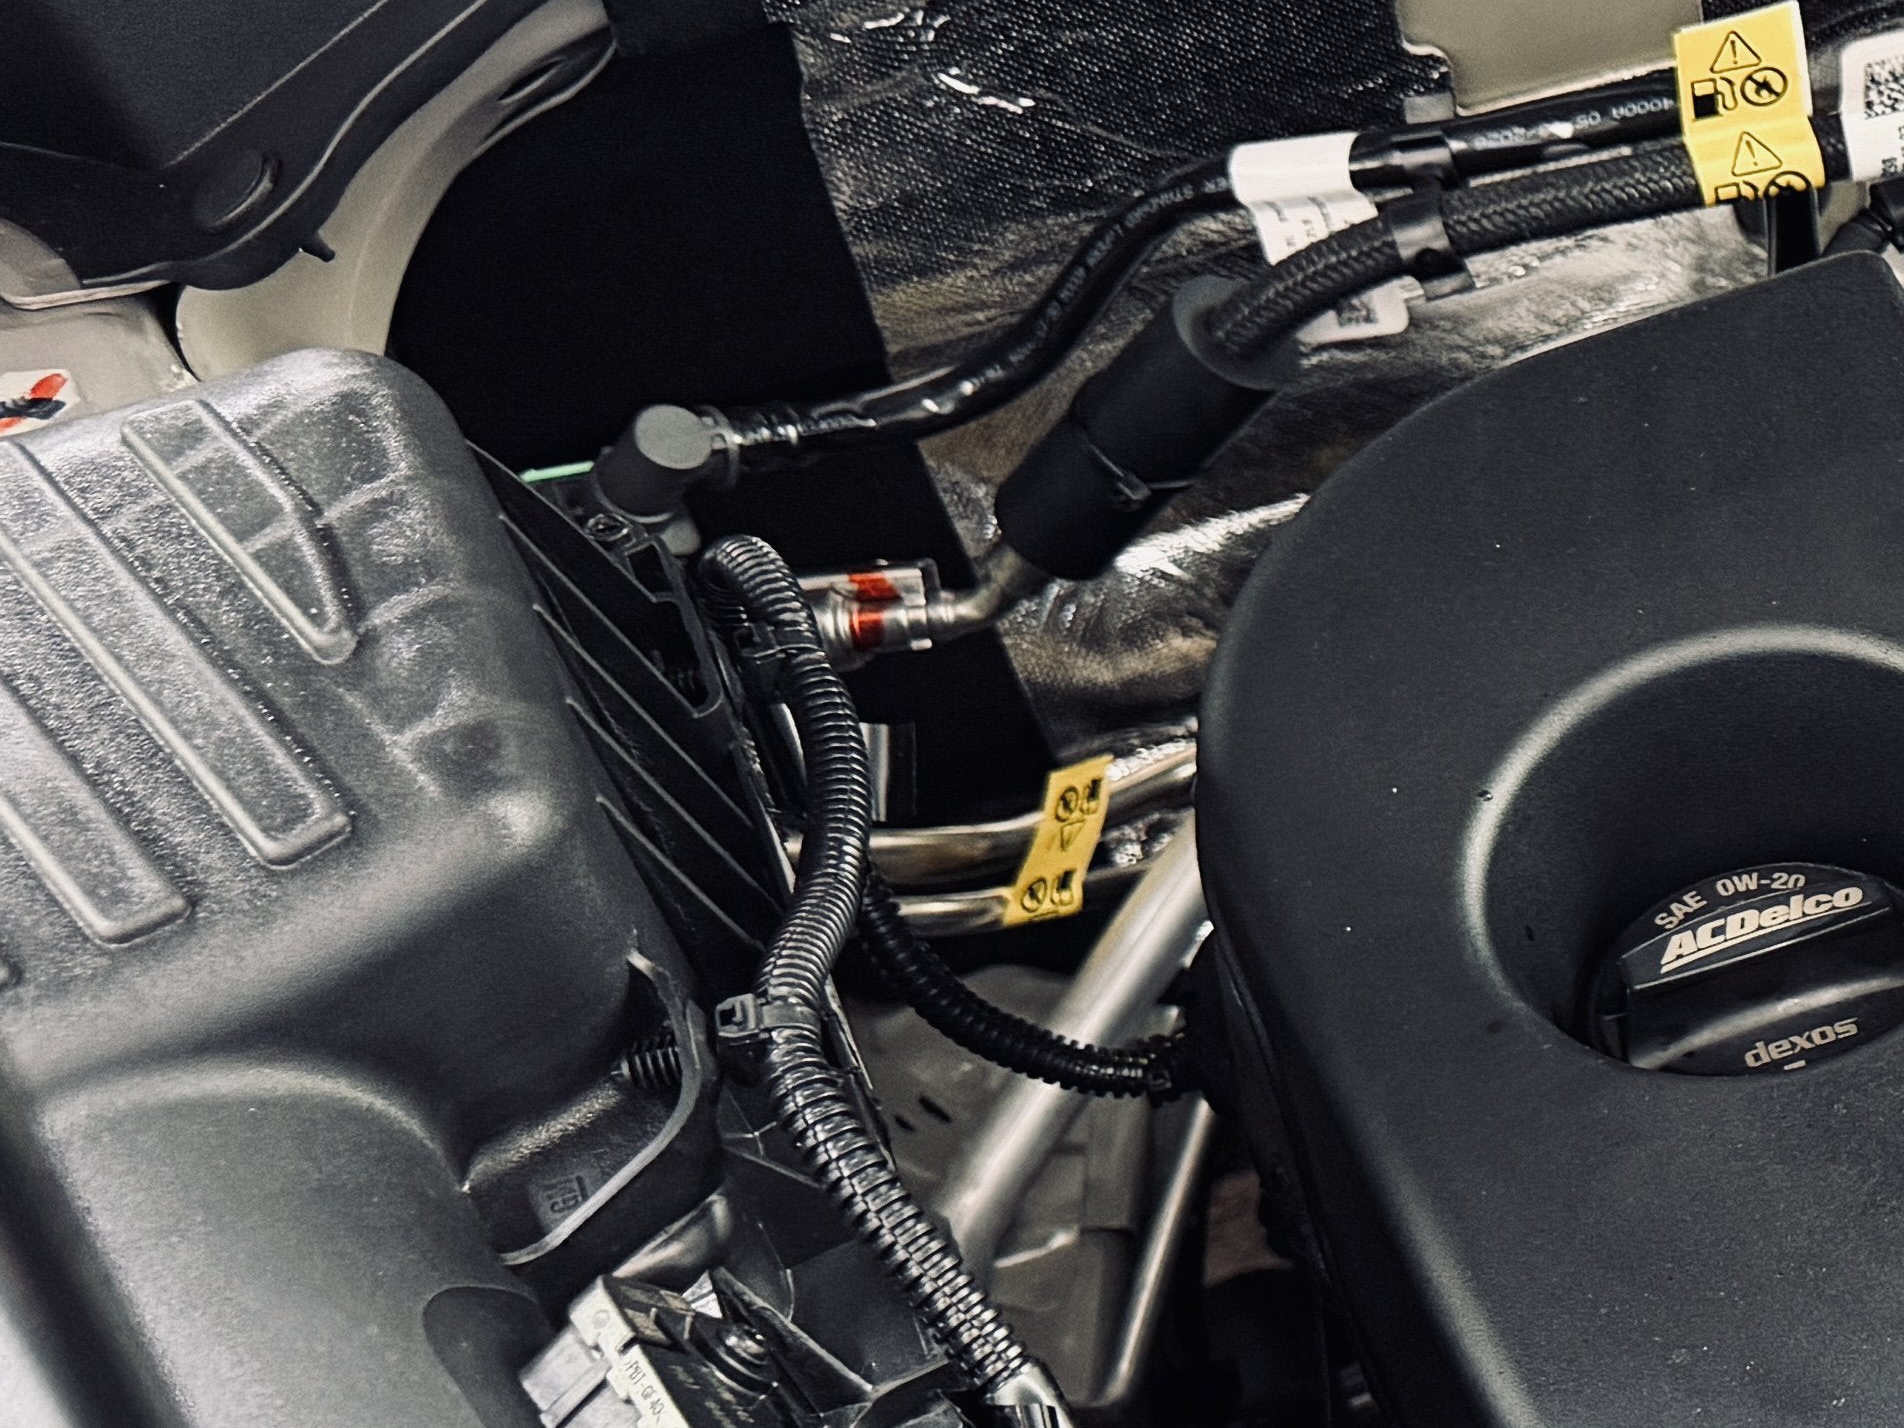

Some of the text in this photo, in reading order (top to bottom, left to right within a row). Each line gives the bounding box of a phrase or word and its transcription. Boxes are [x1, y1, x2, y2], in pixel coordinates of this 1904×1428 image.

[1654, 872, 1806, 929] SAE 0W-20
[1660, 886, 1864, 956] ACDelco
[1744, 1017, 1859, 1068] dexos
